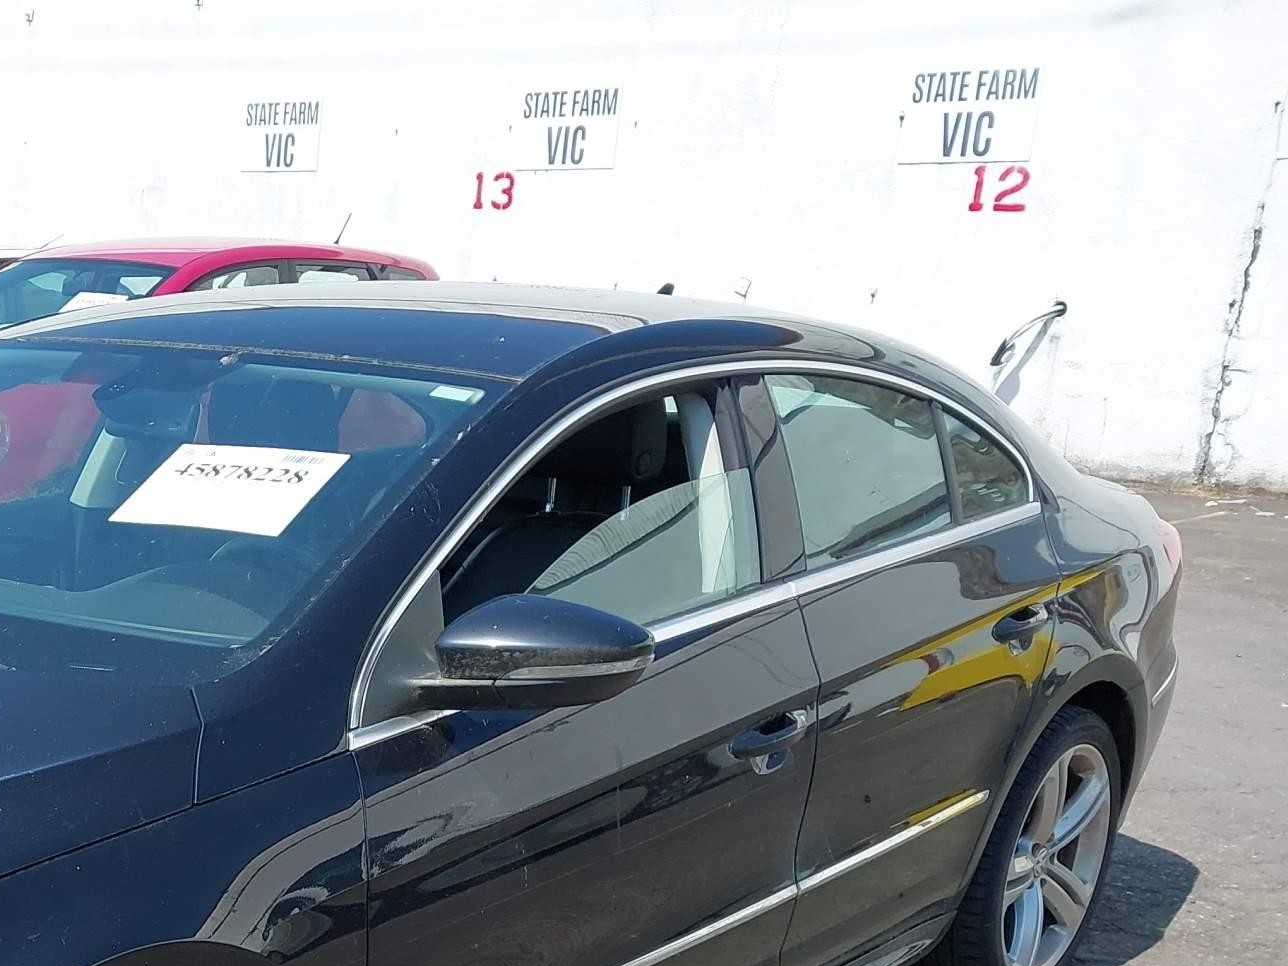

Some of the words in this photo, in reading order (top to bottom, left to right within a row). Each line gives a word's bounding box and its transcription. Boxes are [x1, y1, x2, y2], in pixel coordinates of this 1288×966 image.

[912, 71, 971, 103] STATE
[975, 67, 1040, 101] FARM
[246, 102, 280, 126] STATE
[283, 100, 320, 126] FARM
[523, 91, 568, 119] STATE
[571, 88, 619, 117] FARM
[265, 132, 296, 168] VIC
[547, 125, 586, 165] VIC
[942, 110, 994, 157] VIC
[472, 171, 515, 210] 13
[968, 165, 1031, 212] 12
[175, 462, 309, 484] 45878228
